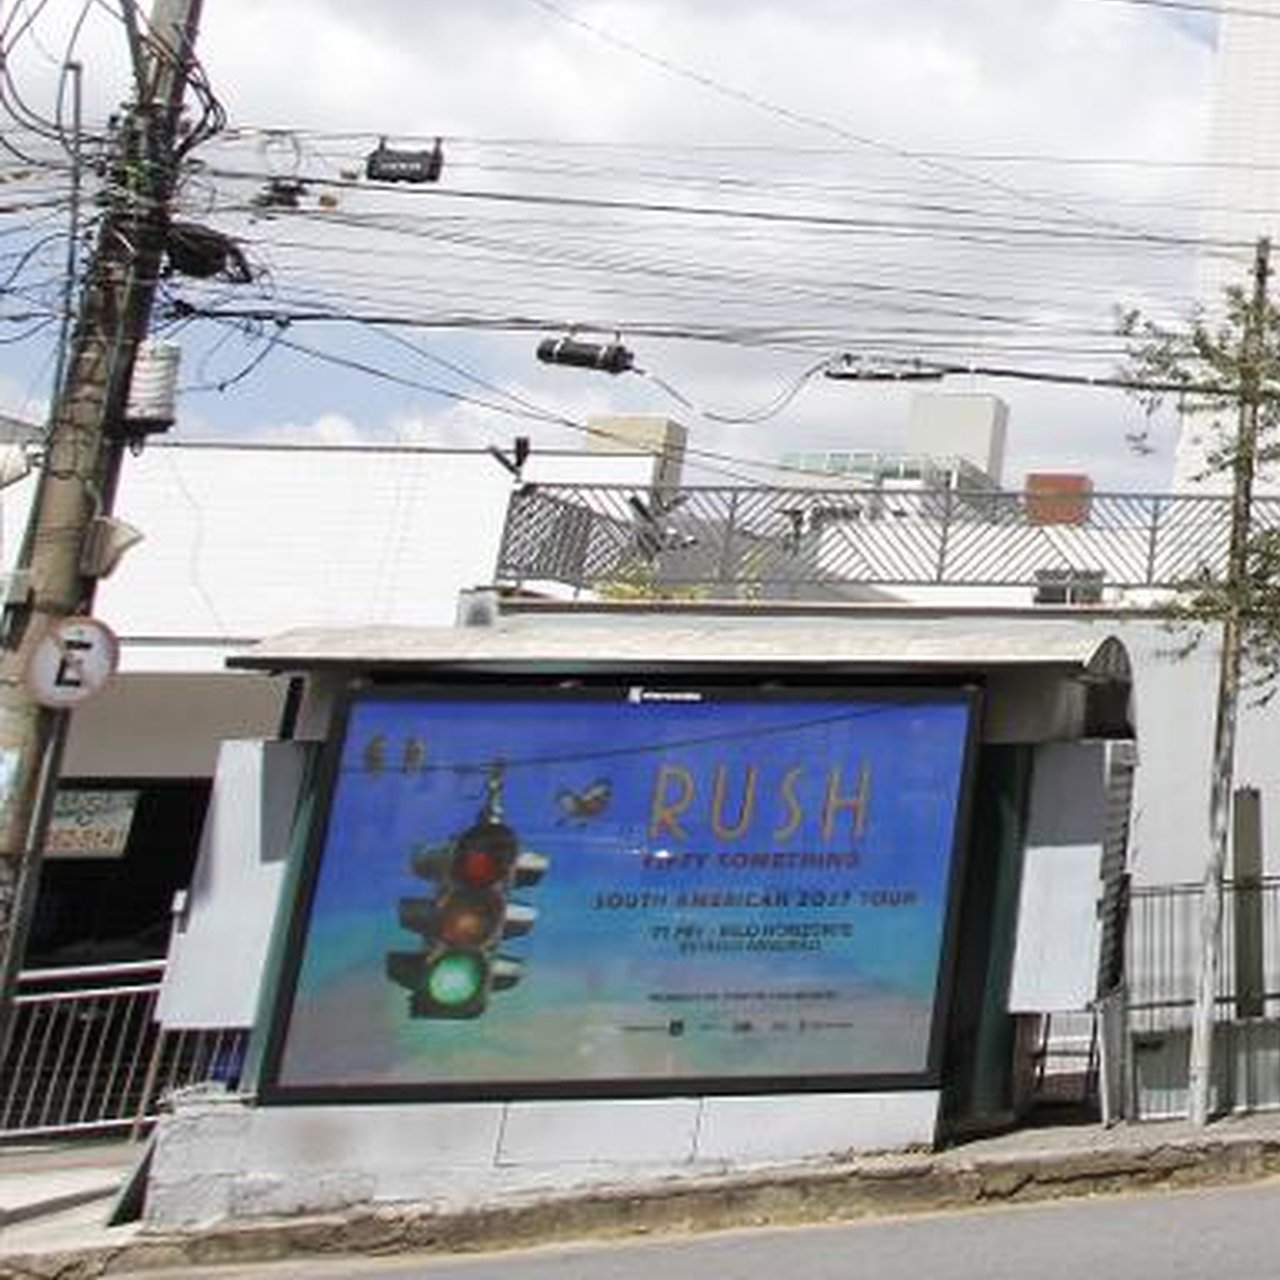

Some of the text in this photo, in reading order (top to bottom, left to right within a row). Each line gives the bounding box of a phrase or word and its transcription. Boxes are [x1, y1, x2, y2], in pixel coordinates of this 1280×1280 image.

[648, 756, 873, 843] RUSH
[719, 851, 862, 870] SOMETHING
[591, 889, 917, 910] SOUTH AMERICAN 2017 TOUR
